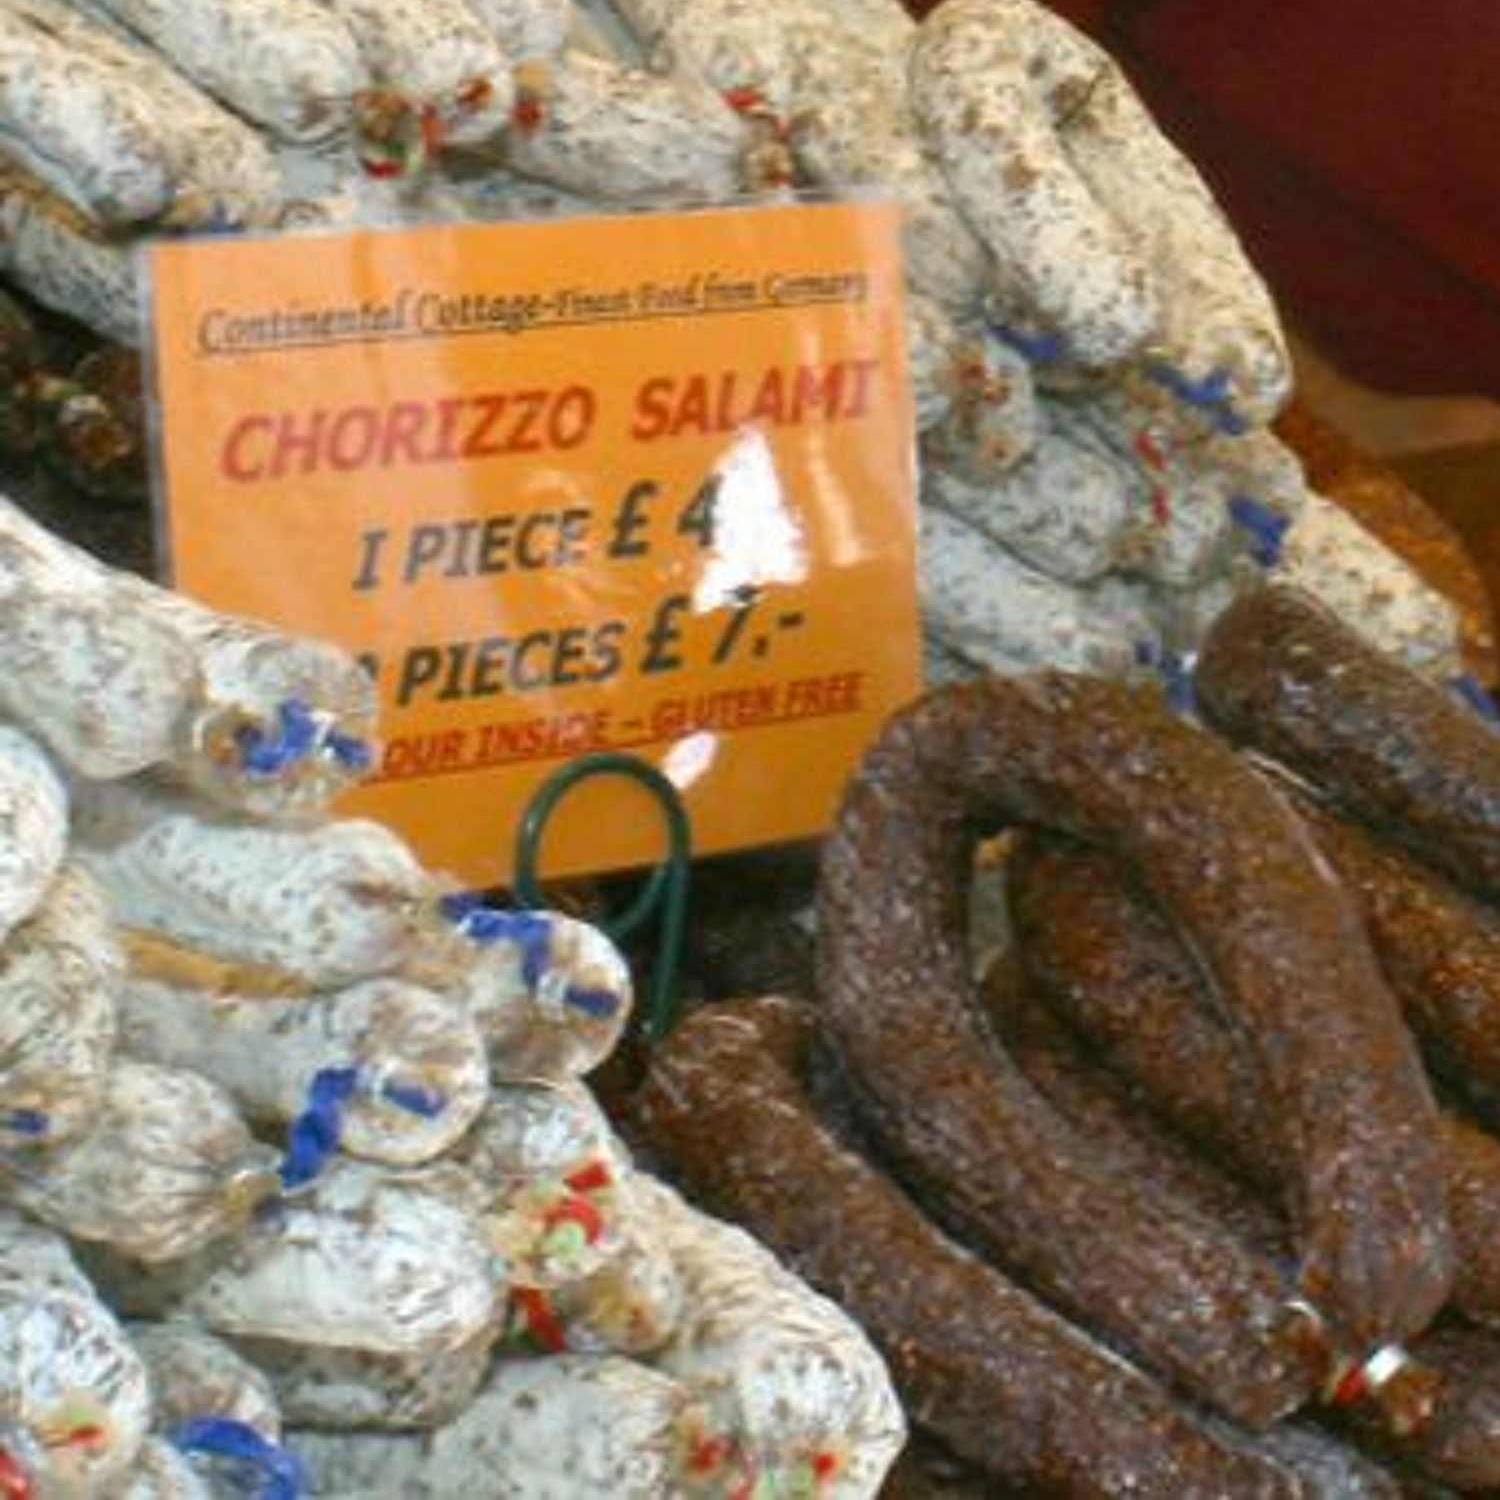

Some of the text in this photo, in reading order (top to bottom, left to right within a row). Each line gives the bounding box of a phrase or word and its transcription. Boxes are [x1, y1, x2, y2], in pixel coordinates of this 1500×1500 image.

[198, 290, 413, 351] Continental
[220, 358, 880, 483] CHORIZZO SALAMI
[403, 509, 592, 583] PIECE
[608, 478, 658, 559] £
[398, 621, 626, 706] PIECES
[638, 593, 692, 675] £
[651, 684, 784, 735] GLUTEN
[786, 670, 866, 718] FREE
